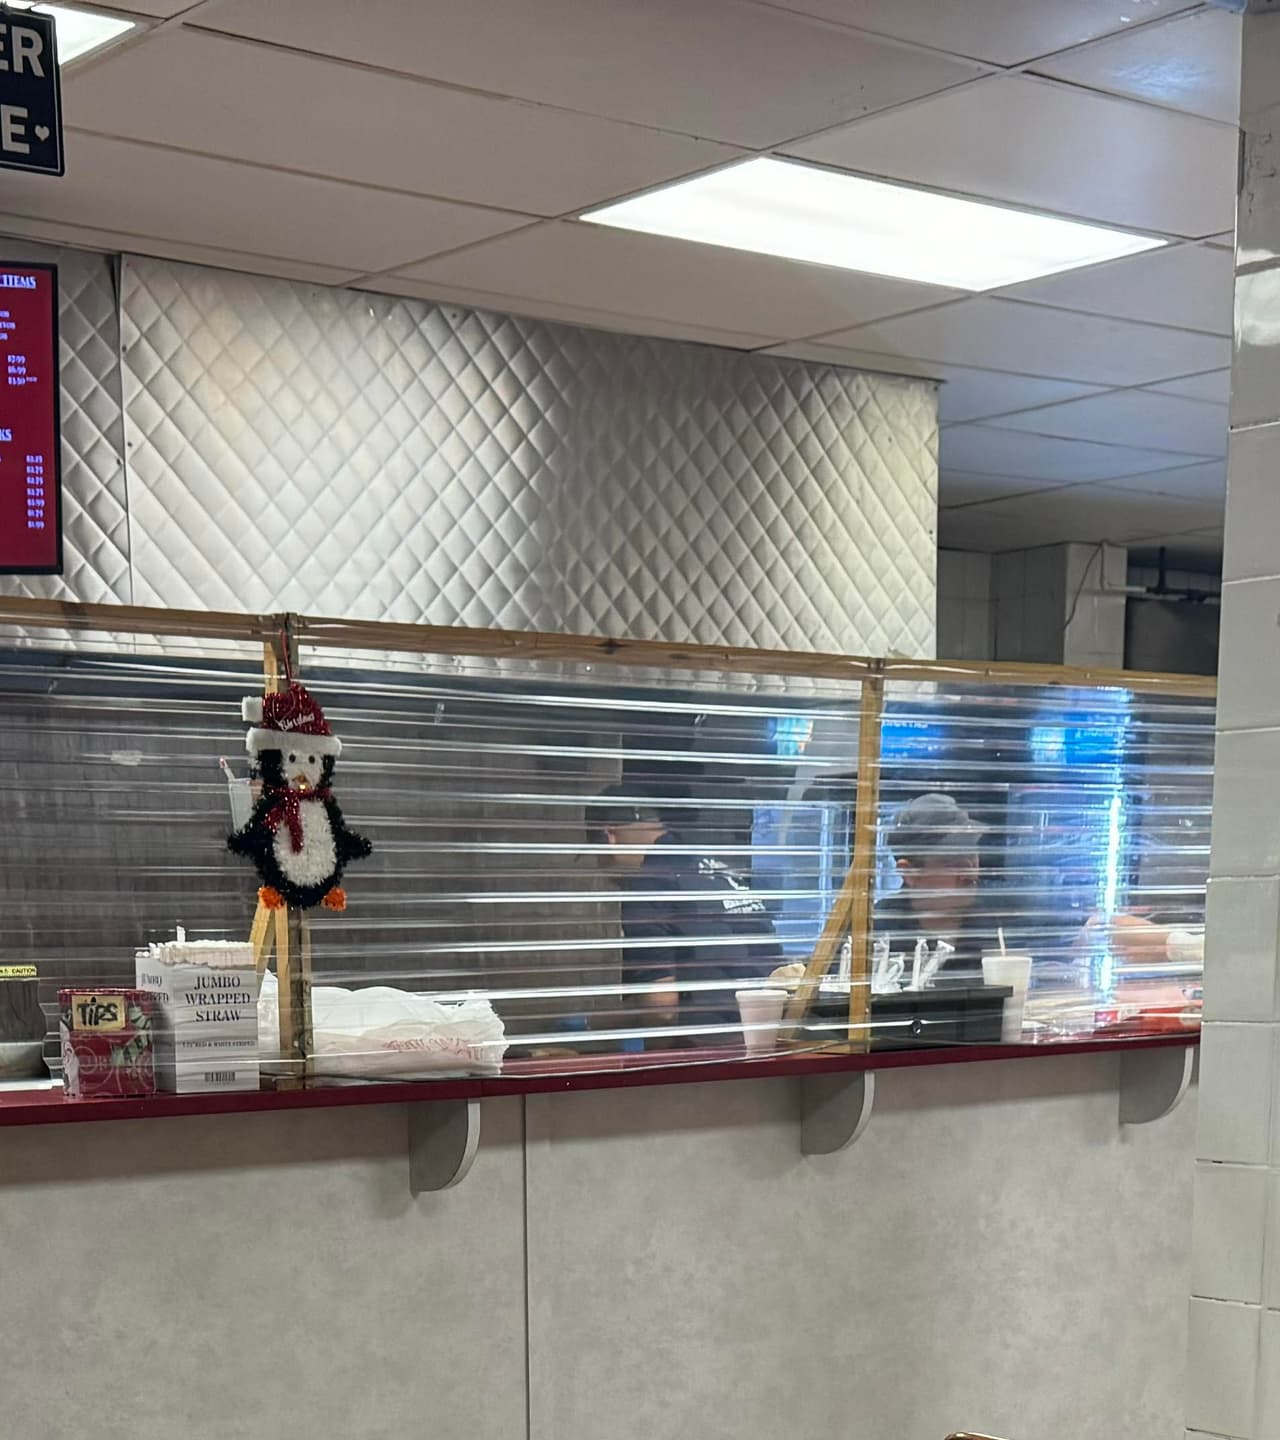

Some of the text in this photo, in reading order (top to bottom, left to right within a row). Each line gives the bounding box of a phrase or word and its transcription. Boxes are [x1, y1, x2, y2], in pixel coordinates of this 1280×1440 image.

[1, 274, 35, 288] ITEMS
[194, 976, 241, 990] JUMBO
[185, 992, 251, 1006] WRAPPED
[195, 1009, 241, 1023] STRAW
